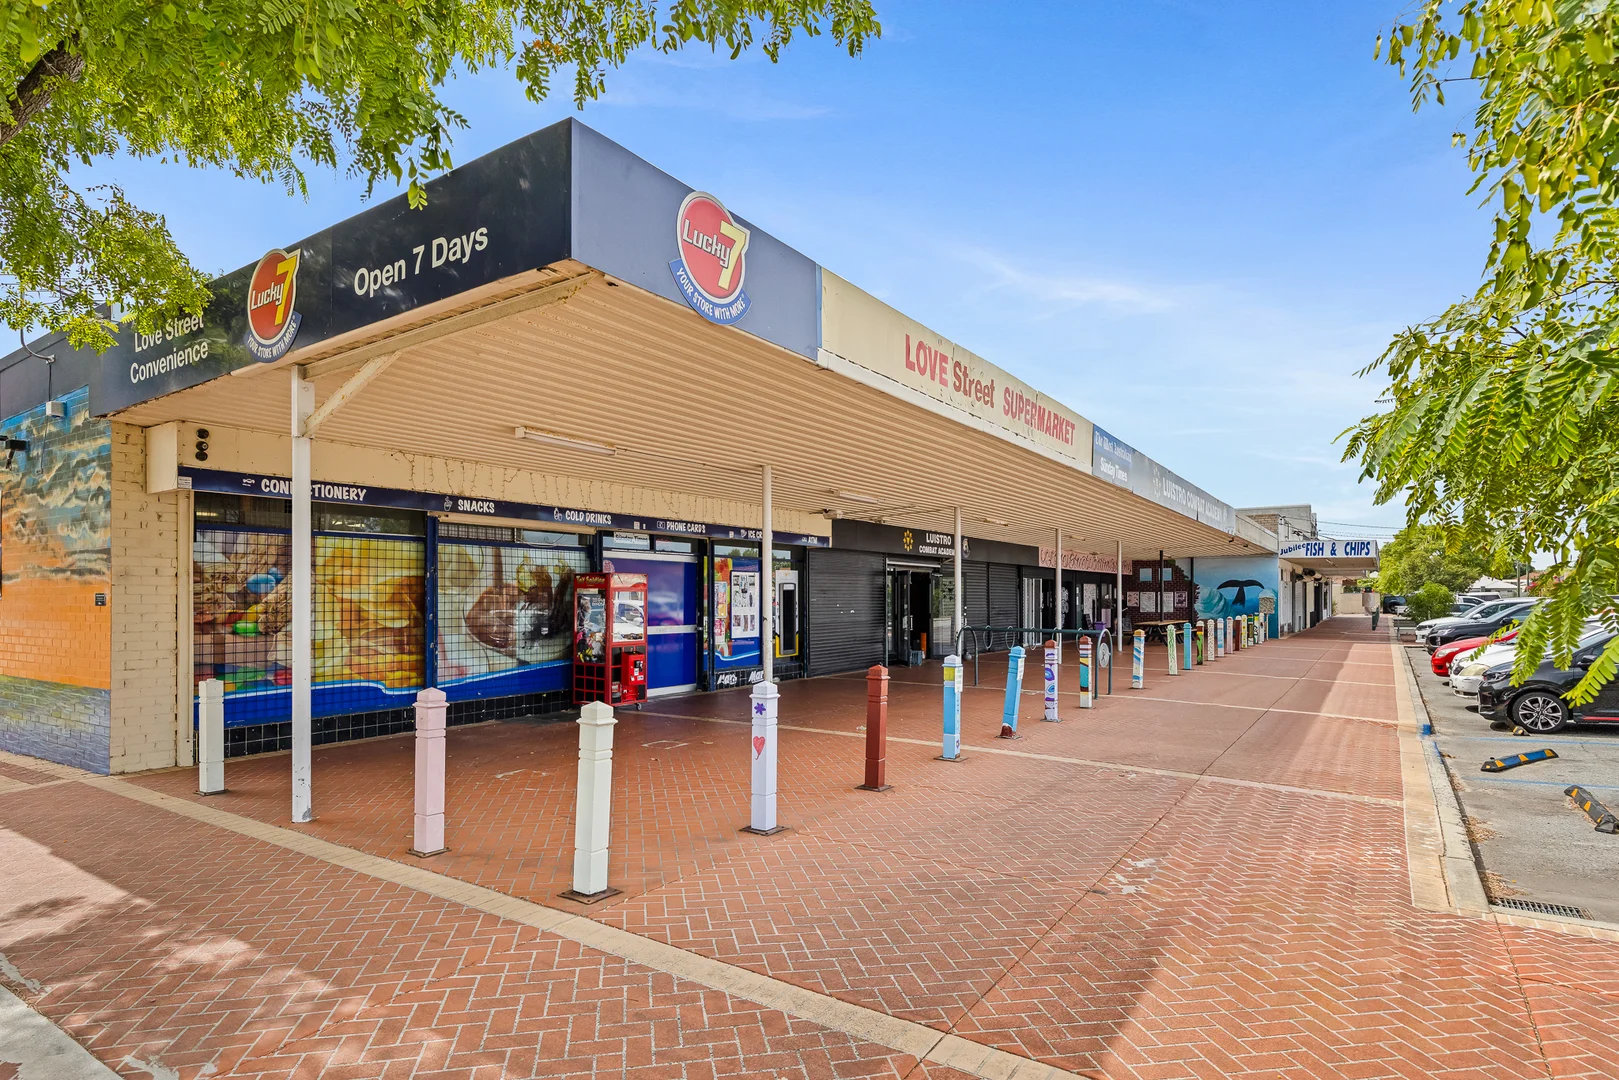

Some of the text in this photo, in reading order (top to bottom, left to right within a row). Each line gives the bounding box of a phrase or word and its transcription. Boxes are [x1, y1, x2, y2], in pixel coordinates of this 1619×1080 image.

[354, 227, 489, 298] Open 7 Days
[682, 218, 747, 291] Lucky 7
[251, 254, 297, 326] Lucky 7
[676, 267, 694, 297] YOUR
[692, 292, 713, 317] STORE
[713, 306, 731, 320] WITH
[134, 311, 204, 353] Love Street
[247, 334, 258, 354] YOUR
[257, 347, 272, 359] STORE
[271, 340, 285, 357] WITH
[130, 341, 209, 384] Convenience
[905, 333, 1076, 446] LOVE Street SUPERMARKET
[1100, 457, 1128, 482] Sunday Times
[261, 478, 367, 501] CONTIONERY
[1162, 477, 1187, 505] LUISTRO
[457, 499, 495, 514] SNACKS
[565, 510, 612, 525] COLD DRINKS
[666, 521, 687, 531] PHONE
[926, 532, 952, 545] LUISTRO
[919, 545, 955, 556] COMBAT ACADEM
[1305, 542, 1324, 556] FISH
[1330, 542, 1337, 556] &
[1344, 541, 1371, 556] CHIPS
